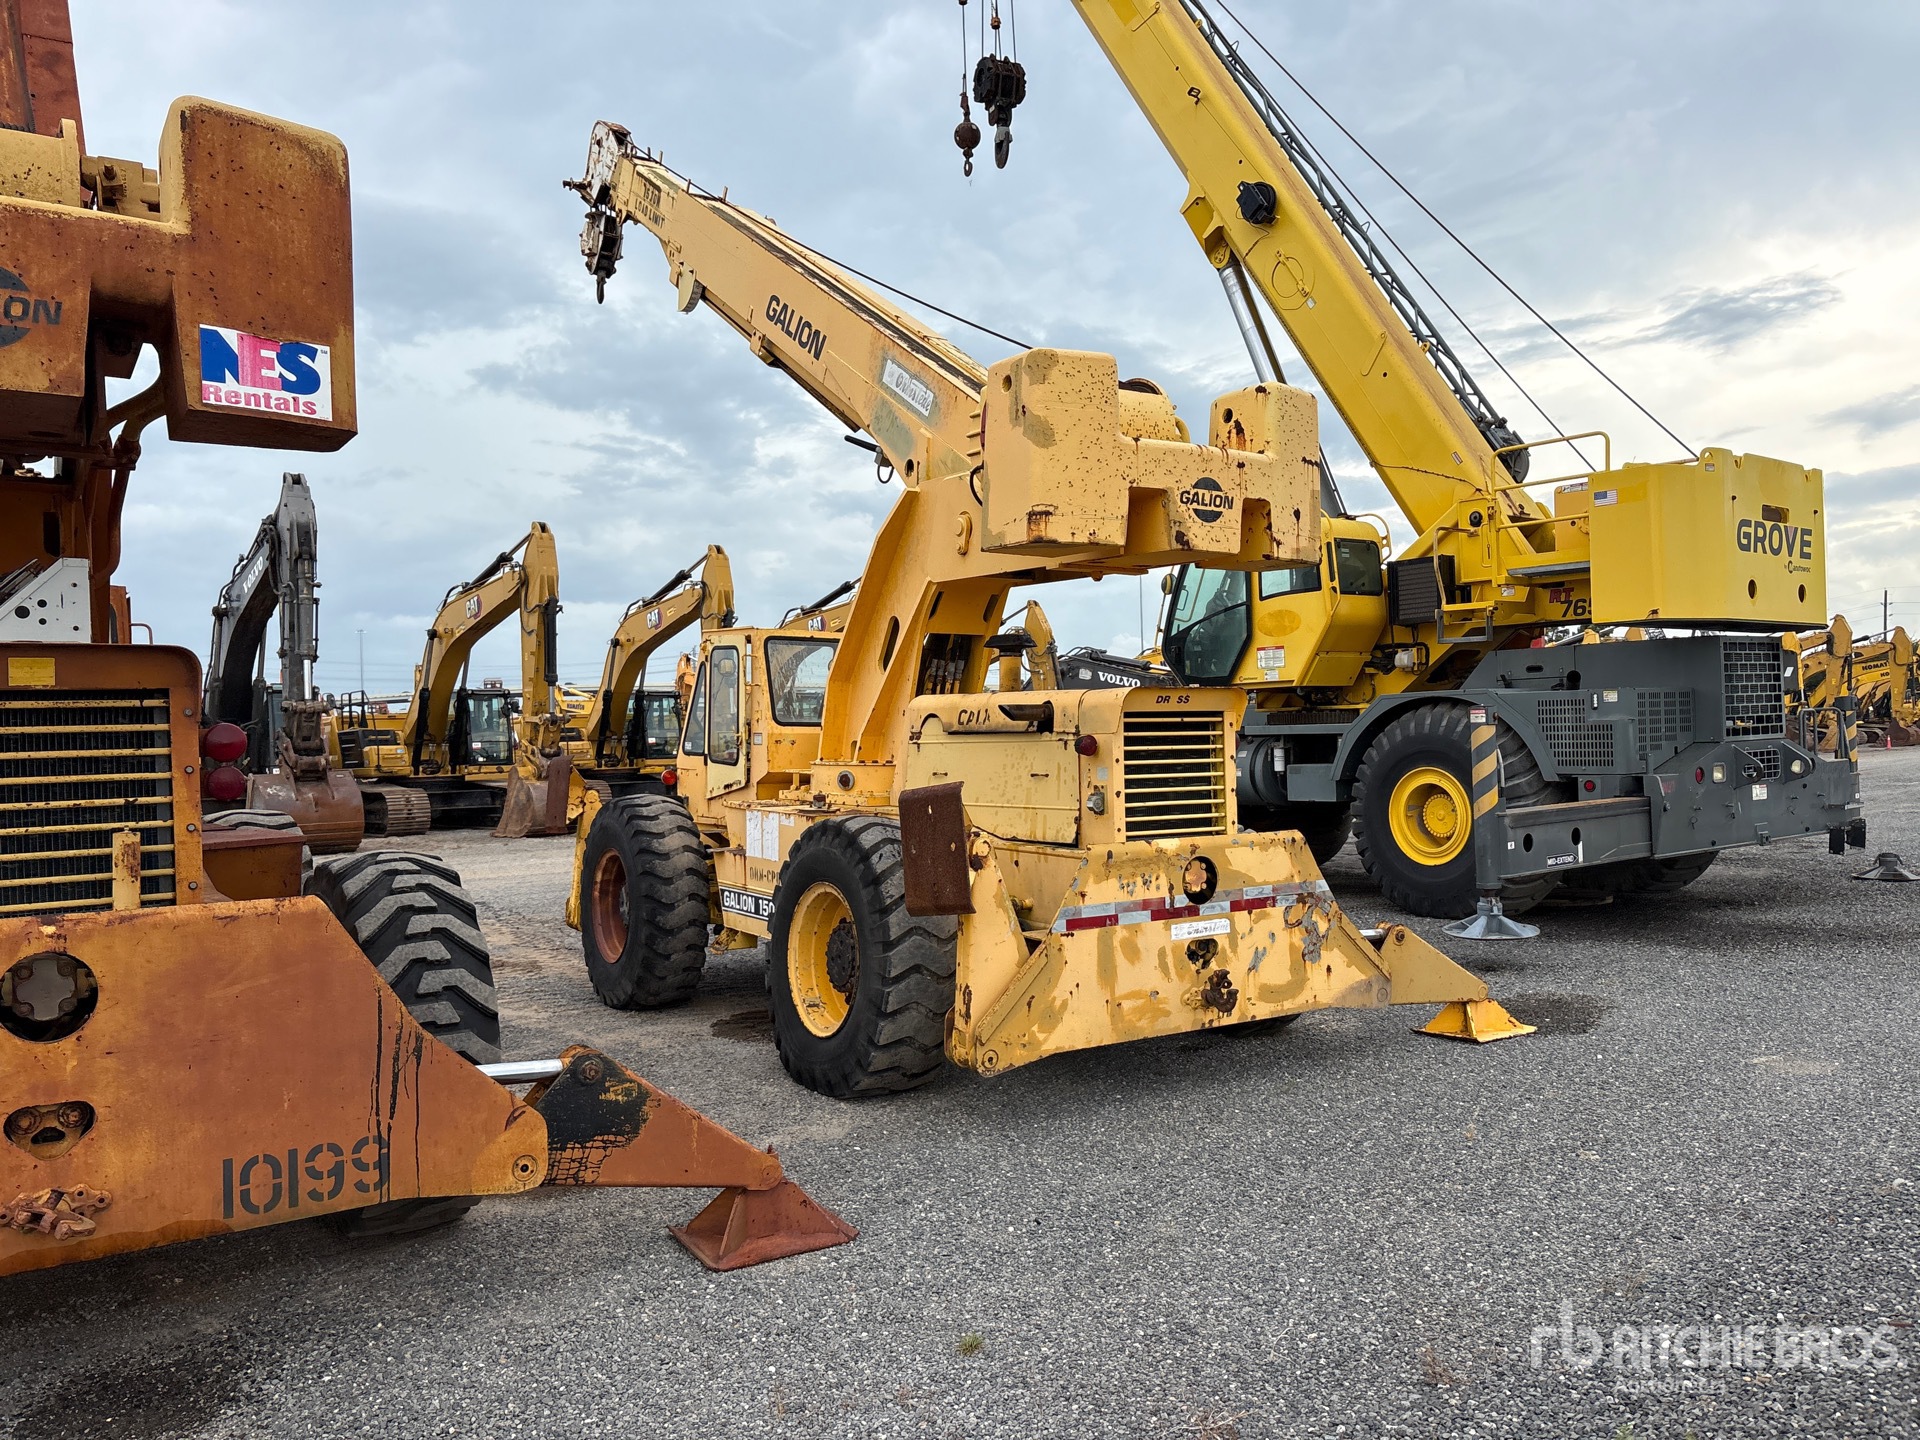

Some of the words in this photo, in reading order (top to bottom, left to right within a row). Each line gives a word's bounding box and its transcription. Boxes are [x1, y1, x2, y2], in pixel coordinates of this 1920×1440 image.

[765, 294, 827, 361] GALION
[199, 327, 321, 396] NES
[202, 383, 317, 415] Rentals
[1180, 490, 1234, 510] GALION
[1737, 518, 1812, 560] GROVE
[243, 555, 264, 594] VOLVO
[1549, 587, 1574, 604] RT
[465, 595, 479, 619] CAT
[647, 608, 659, 629] CAT
[808, 616, 822, 632] CAT
[1861, 660, 1890, 671] KOMAT
[1097, 671, 1141, 688] VOLVO
[1155, 695, 1171, 704] DR
[1547, 855, 1575, 866] MID-EXTEND
[723, 891, 755, 913] GALION
[222, 1134, 390, 1210] 10199
